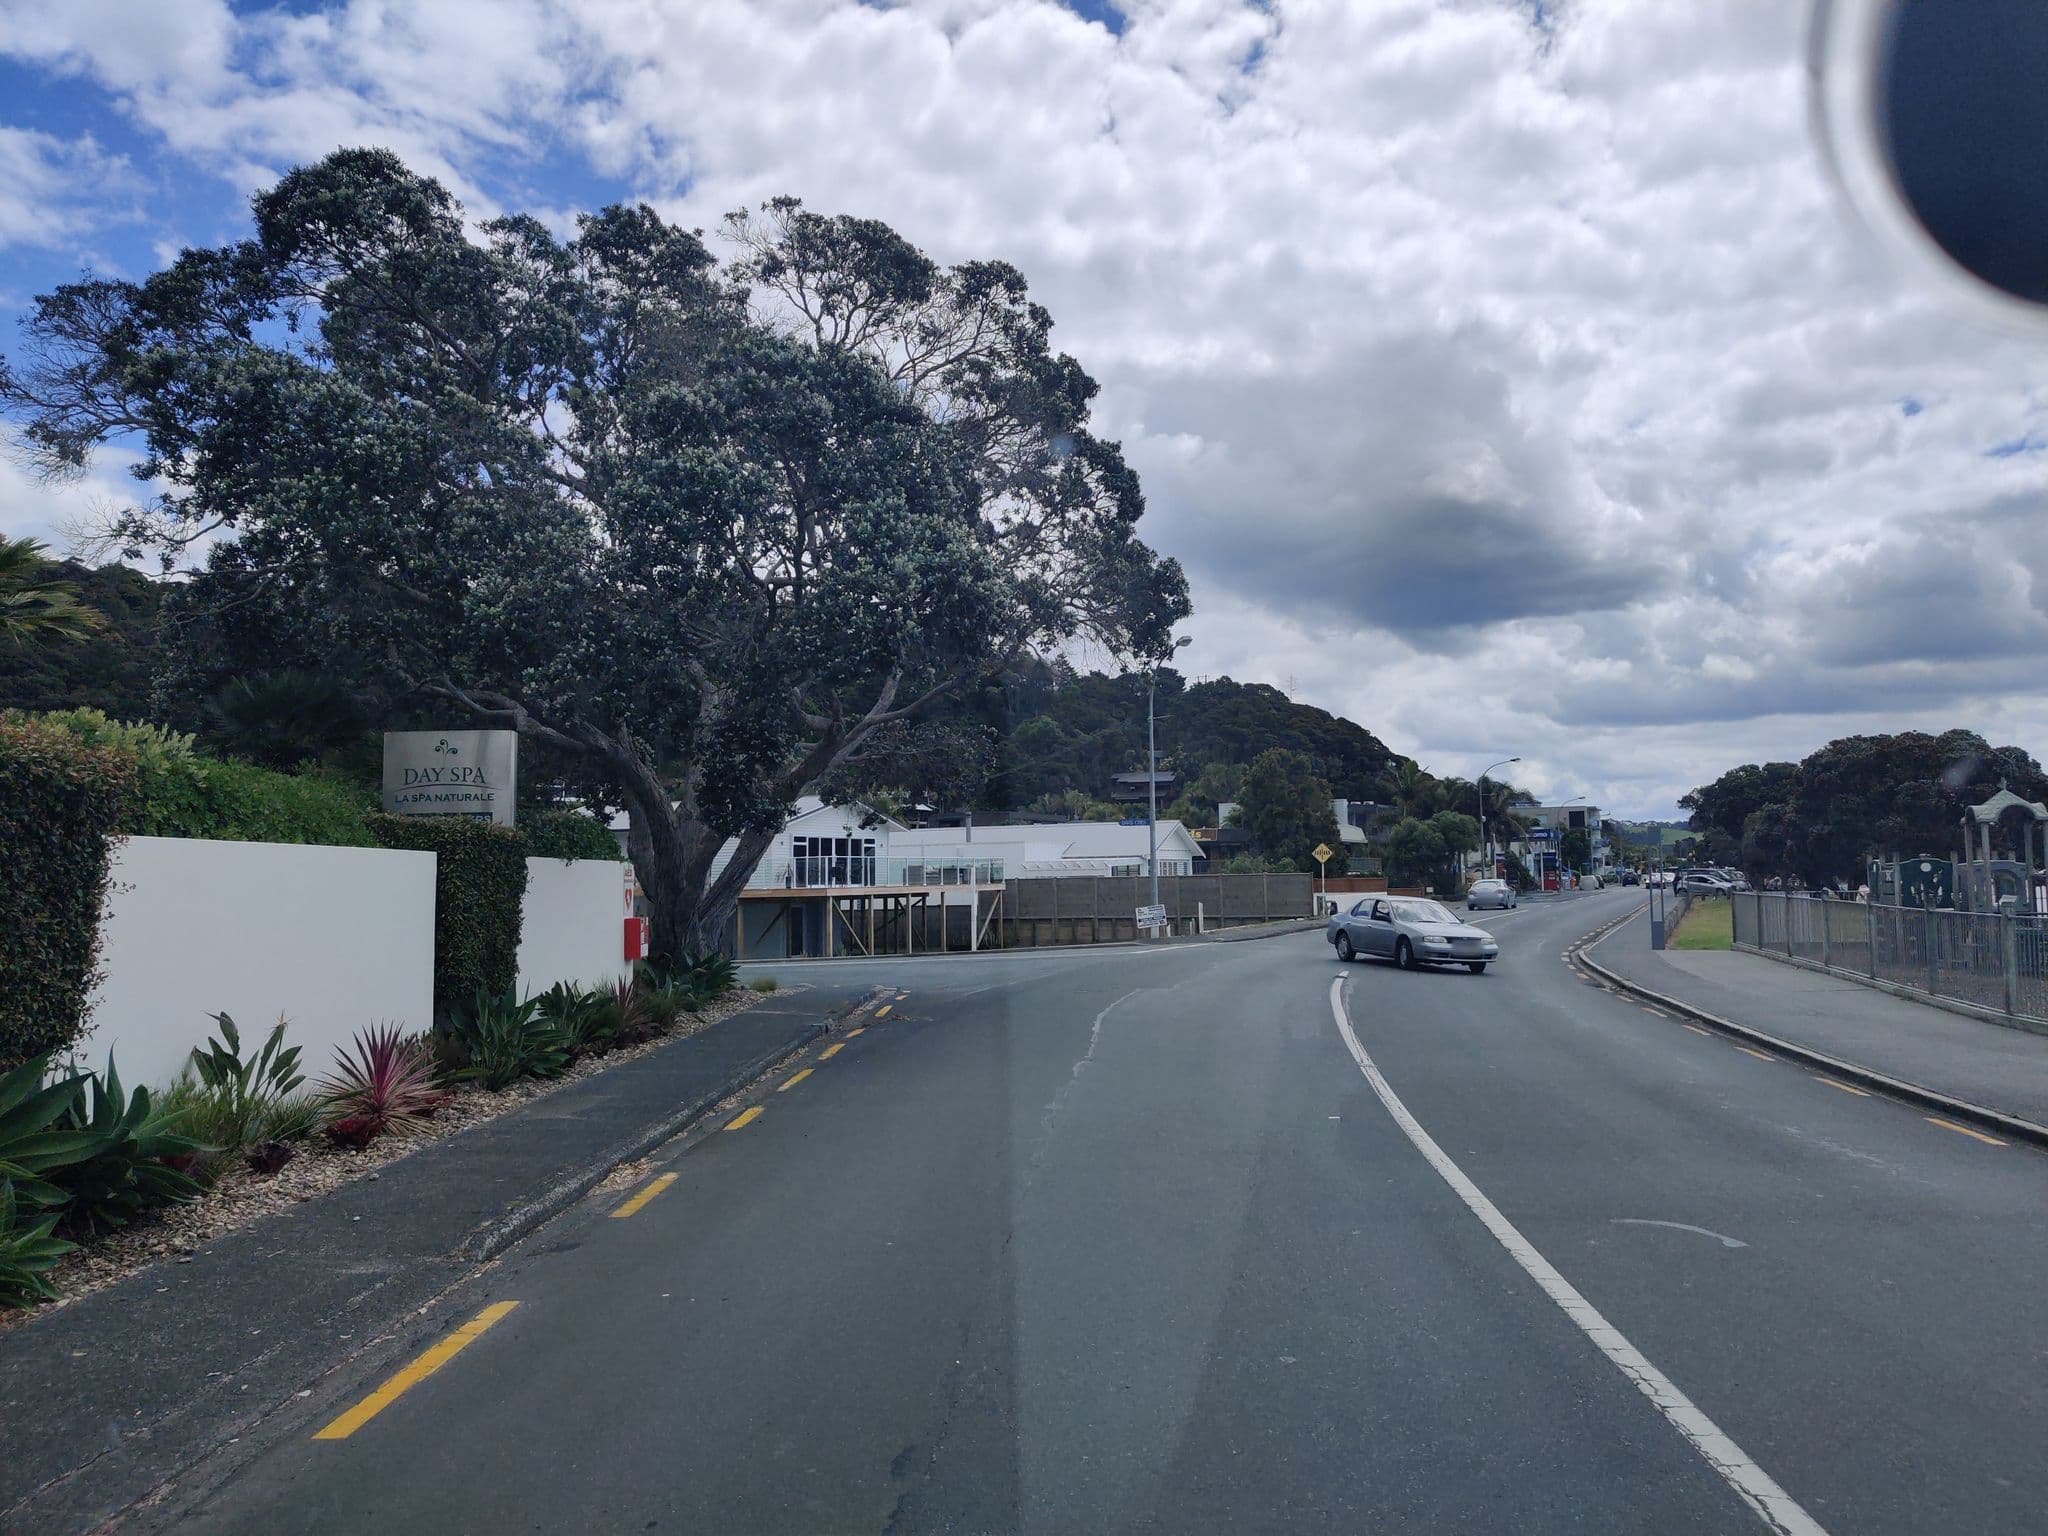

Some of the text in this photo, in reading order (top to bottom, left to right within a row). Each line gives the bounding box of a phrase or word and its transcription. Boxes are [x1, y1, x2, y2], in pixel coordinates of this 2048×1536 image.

[403, 766, 487, 785] DAY SPA
[394, 793, 495, 803] LA SPA NATURALE
